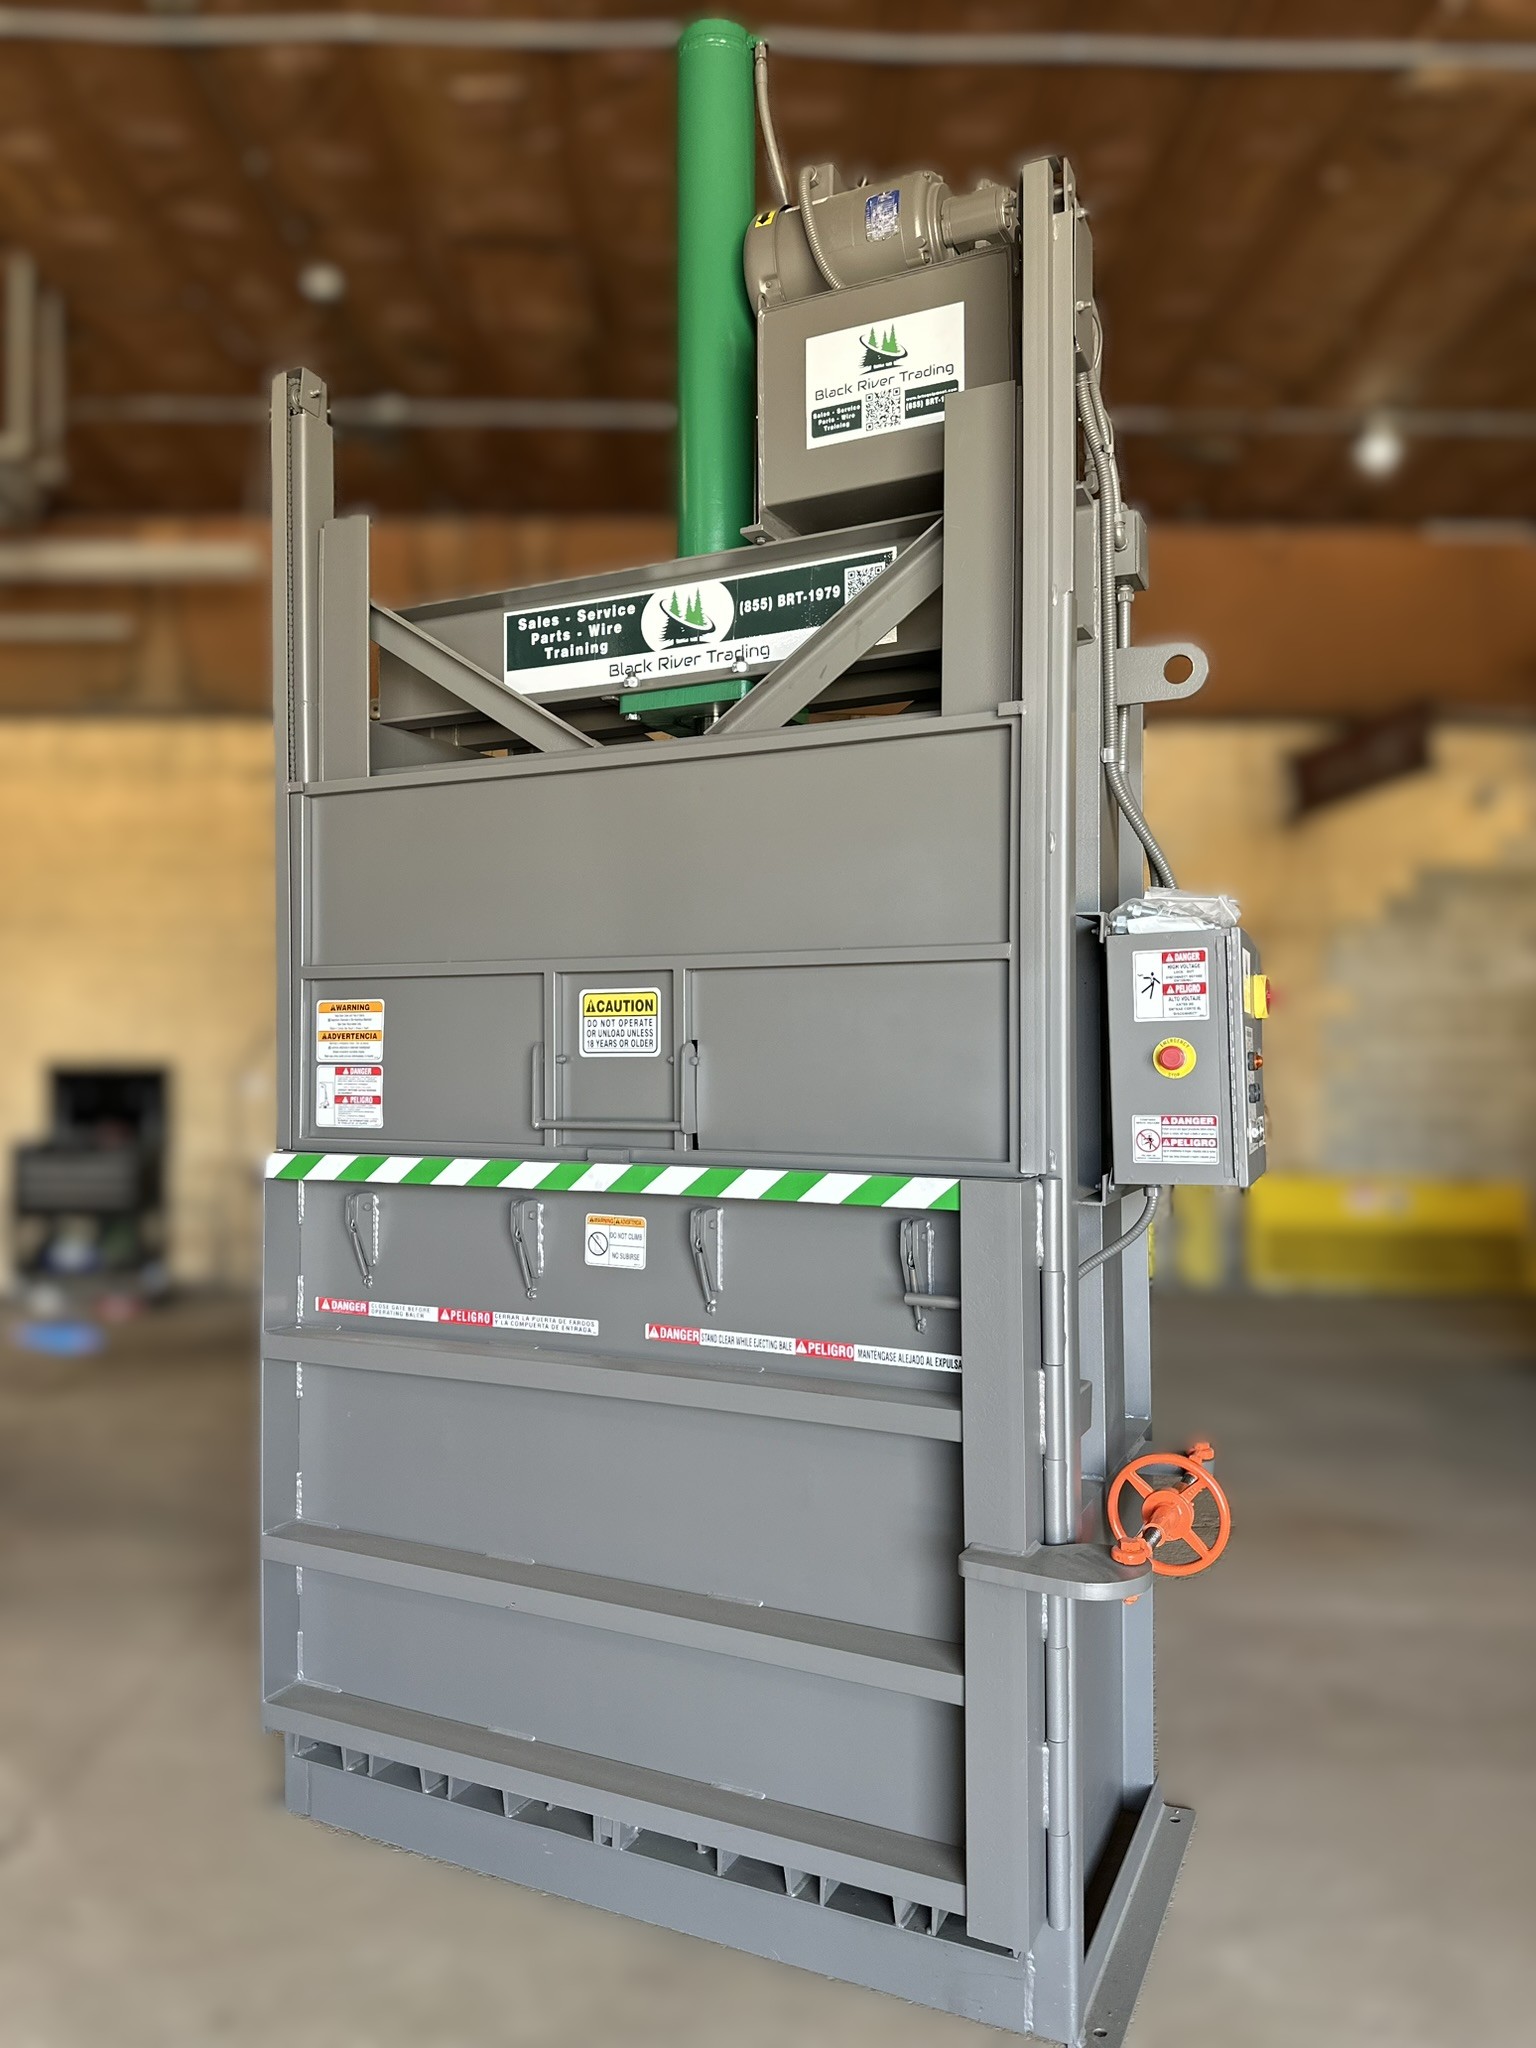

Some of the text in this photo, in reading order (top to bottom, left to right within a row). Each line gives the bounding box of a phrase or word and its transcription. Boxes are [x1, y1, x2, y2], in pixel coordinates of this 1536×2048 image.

[815, 363, 954, 401] Black River Trading
[813, 411, 830, 420] Sales
[836, 404, 860, 414] Service
[818, 417, 835, 426] Parts
[823, 421, 850, 432] Training
[739, 584, 841, 616] (855) BRT-1979
[518, 615, 560, 631] Sales
[577, 604, 636, 623] Service
[531, 629, 571, 646] Parts
[588, 623, 622, 638] Wire
[544, 641, 608, 660] Training
[609, 643, 770, 677] Black River Trading
[1174, 952, 1200, 962] DANGER
[1176, 984, 1201, 993] PELIGRO
[596, 999, 653, 1012] CAUTION
[600, 1019, 615, 1027] NOT
[618, 1018, 652, 1027] OPERATE
[586, 1029, 653, 1038] OR UNLOAD UNLESS
[596, 1040, 617, 1048] YEARS
[619, 1039, 628, 1047] OR
[631, 1039, 653, 1047] OLDER
[620, 1252, 640, 1261] SUBIRSE
[331, 1300, 366, 1312] DANGER
[371, 1309, 403, 1317] OPERATING
[450, 1310, 490, 1324] PELIGRO
[510, 1321, 549, 1330] COMPUERTA
[562, 1325, 591, 1333] ENTRADA
[532, 1316, 556, 1324] PUERTA
[569, 1319, 595, 1328] FARDOS
[660, 1327, 700, 1342] DANGER
[701, 1332, 792, 1351] STAND CLEAR WHILE EJECTING BALE
[808, 1342, 854, 1358] PELIGRO
[858, 1348, 896, 1362] MANTÉNGASE
[899, 1353, 924, 1366] ALEJADO
[926, 1356, 933, 1366] AL
